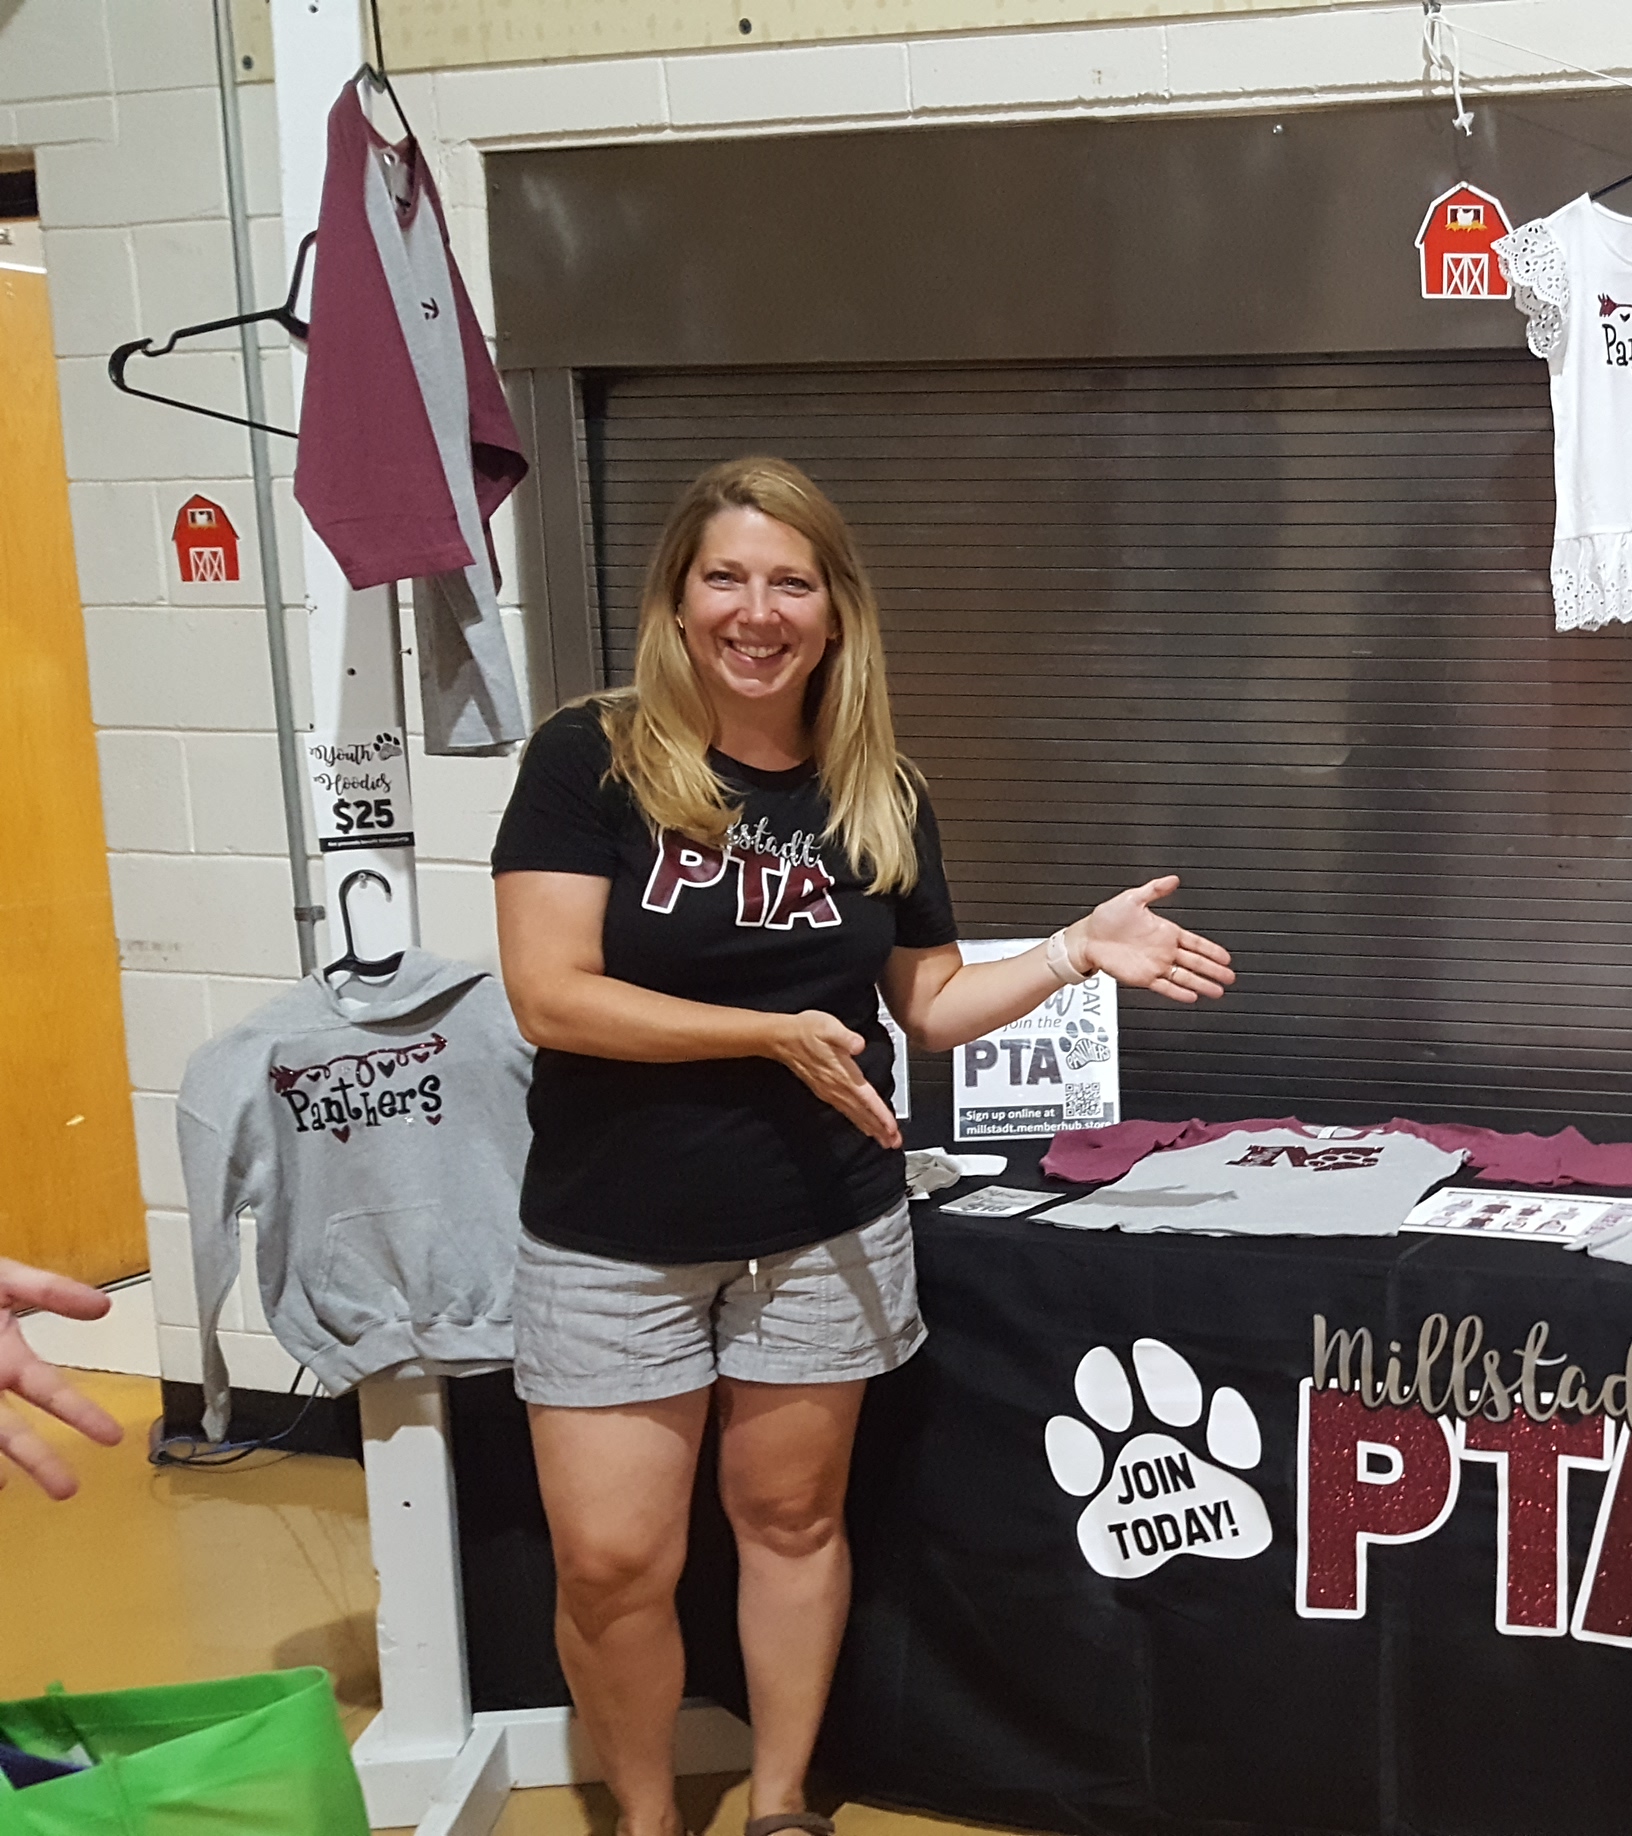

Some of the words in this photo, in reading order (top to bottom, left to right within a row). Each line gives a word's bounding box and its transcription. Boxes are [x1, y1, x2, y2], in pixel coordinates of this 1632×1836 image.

[309, 743, 374, 767] Youth
[313, 773, 391, 796] Hoodies
[333, 798, 394, 835] $25
[641, 826, 842, 930] PTA
[1038, 1016, 1062, 1029] the
[965, 1038, 1063, 1088] PTA
[281, 1074, 442, 1132] Panthers
[966, 1110, 989, 1122] Sign
[991, 1111, 1006, 1122] up
[1007, 1108, 1041, 1119] online
[1043, 1108, 1055, 1118] at
[1117, 1452, 1196, 1505] JOIN
[1108, 1500, 1240, 1560] TODAY!
